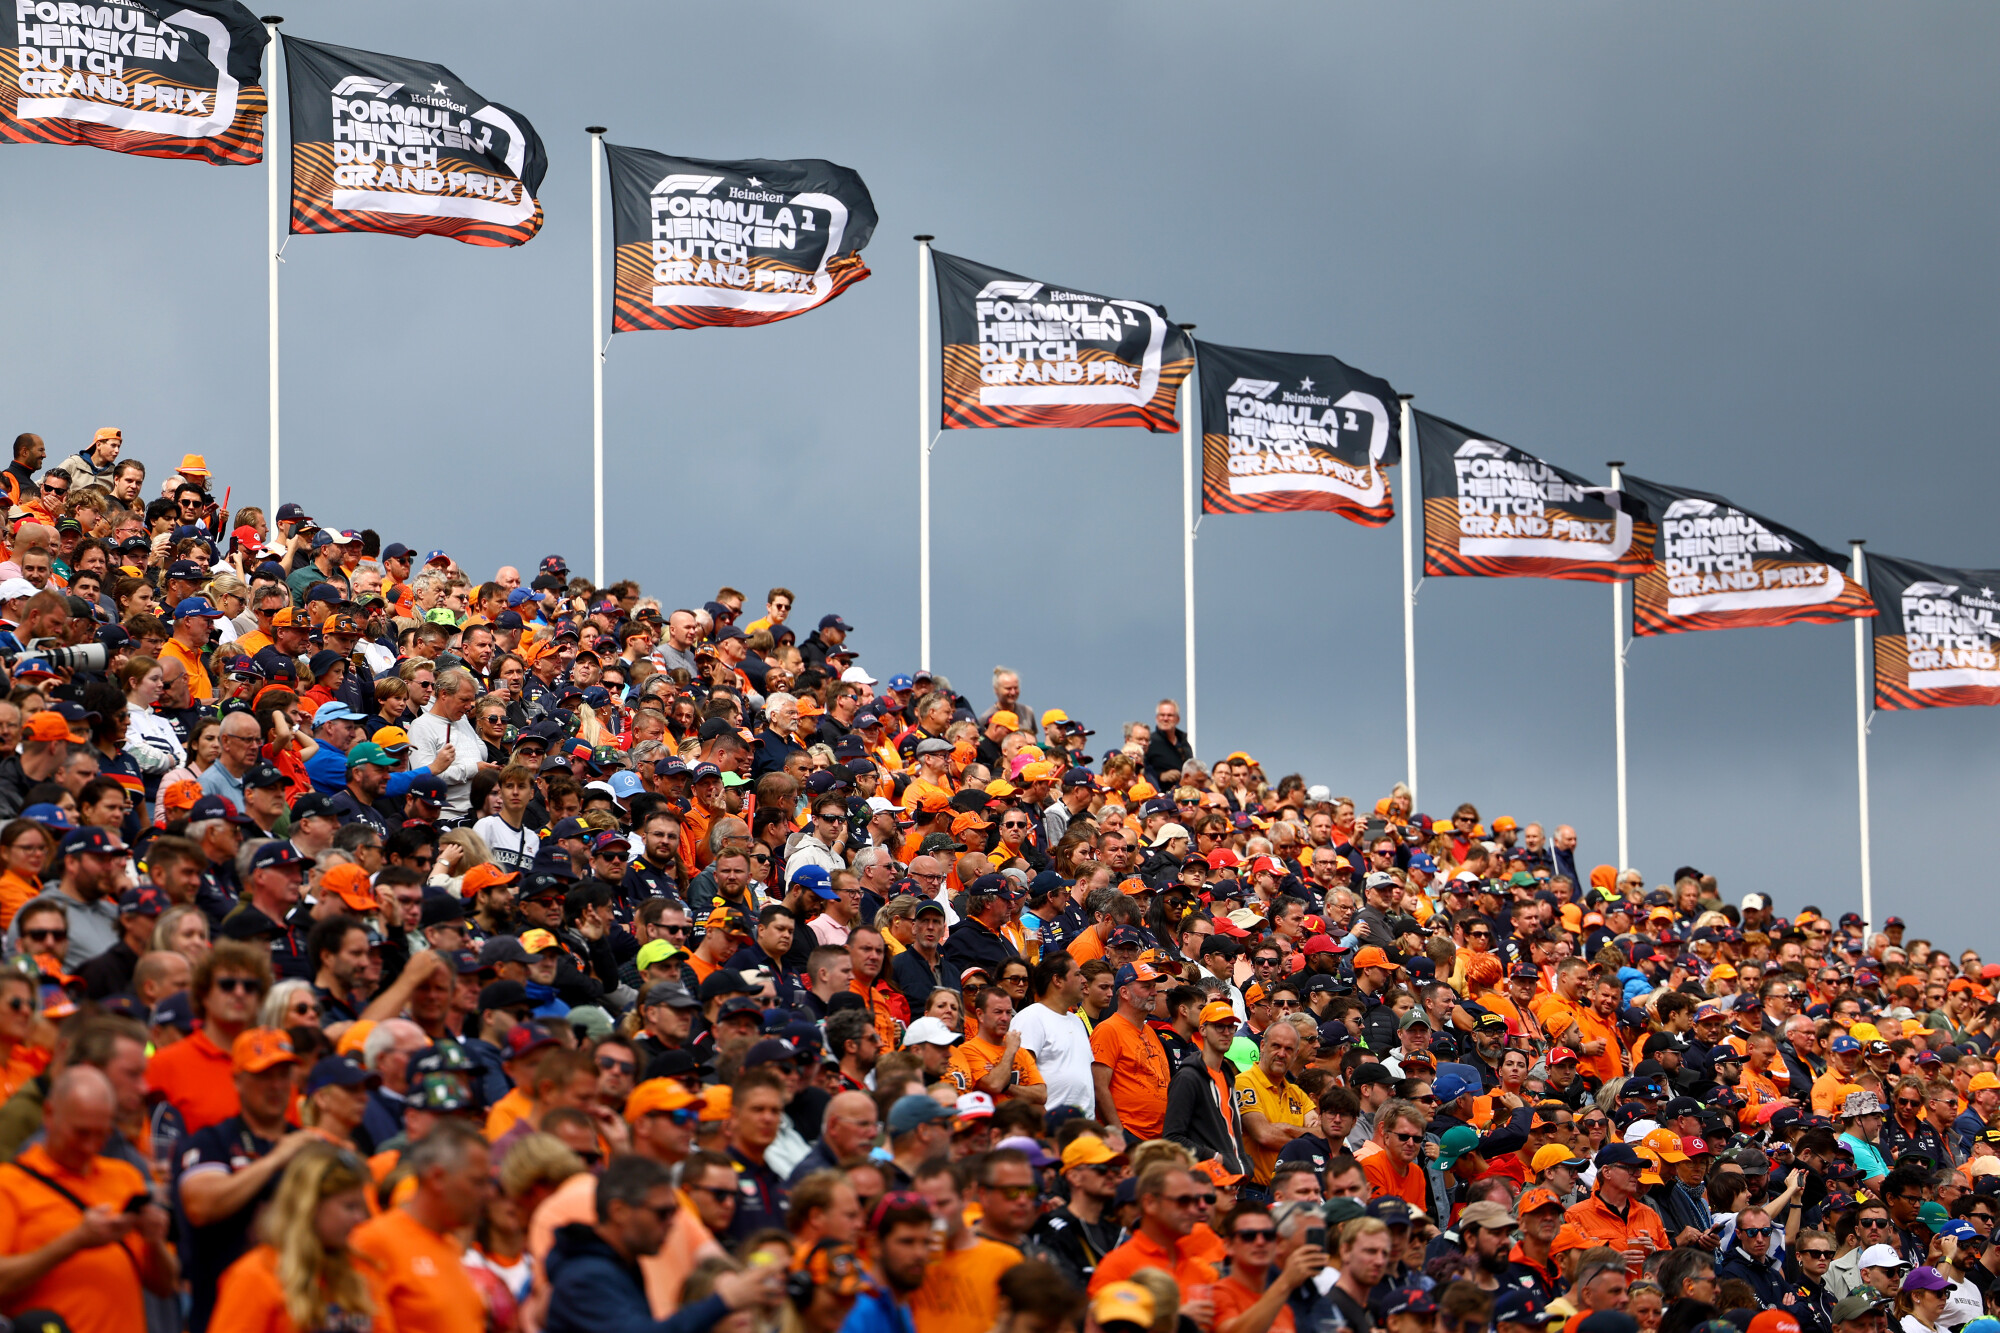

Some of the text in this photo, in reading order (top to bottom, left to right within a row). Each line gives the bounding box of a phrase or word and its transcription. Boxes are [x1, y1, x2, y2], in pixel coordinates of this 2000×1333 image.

[17, 23, 179, 62] HEINEKEN
[18, 46, 123, 78] DUTCH
[18, 71, 212, 113] GRAND PRIX
[410, 93, 466, 114] Heineken
[332, 96, 472, 134] FORMULA
[332, 119, 485, 154] HEINEKEN
[334, 142, 438, 168] DUTCH
[334, 166, 517, 201] GRAND PRIX
[728, 187, 784, 204] Heineken
[650, 196, 816, 232] FORMULA 1
[652, 218, 796, 250] HEINEKEN
[652, 239, 748, 265] DUTCH
[653, 260, 814, 294] GRAND PRIX
[976, 300, 1140, 326] FORMULA 1
[978, 321, 1122, 342] HEINEKEN
[980, 341, 1077, 363] DUTCH
[980, 360, 1140, 386] GRAND PRIX
[1282, 392, 1329, 406] Heineken
[1226, 394, 1359, 432] FORMULA 1
[1228, 415, 1338, 448] HEINEKEN
[1228, 435, 1310, 456] DUTCH
[1228, 453, 1368, 488] GRAND PRIX
[1454, 458, 1564, 482] FORMUL
[1457, 478, 1584, 502] HEINEKEN
[1458, 496, 1544, 517] DUTCH
[1459, 516, 1612, 541] GRAND PRIX
[1662, 516, 1772, 538] FORMUL
[1666, 553, 1752, 577] DUTCH
[1667, 566, 1826, 596] GRAND PRIX
[1902, 598, 2000, 629] FORMUL
[1906, 632, 1991, 652] DUTCH
[1908, 650, 1996, 669] GRAND
[1236, 1088, 1256, 1108] 23
